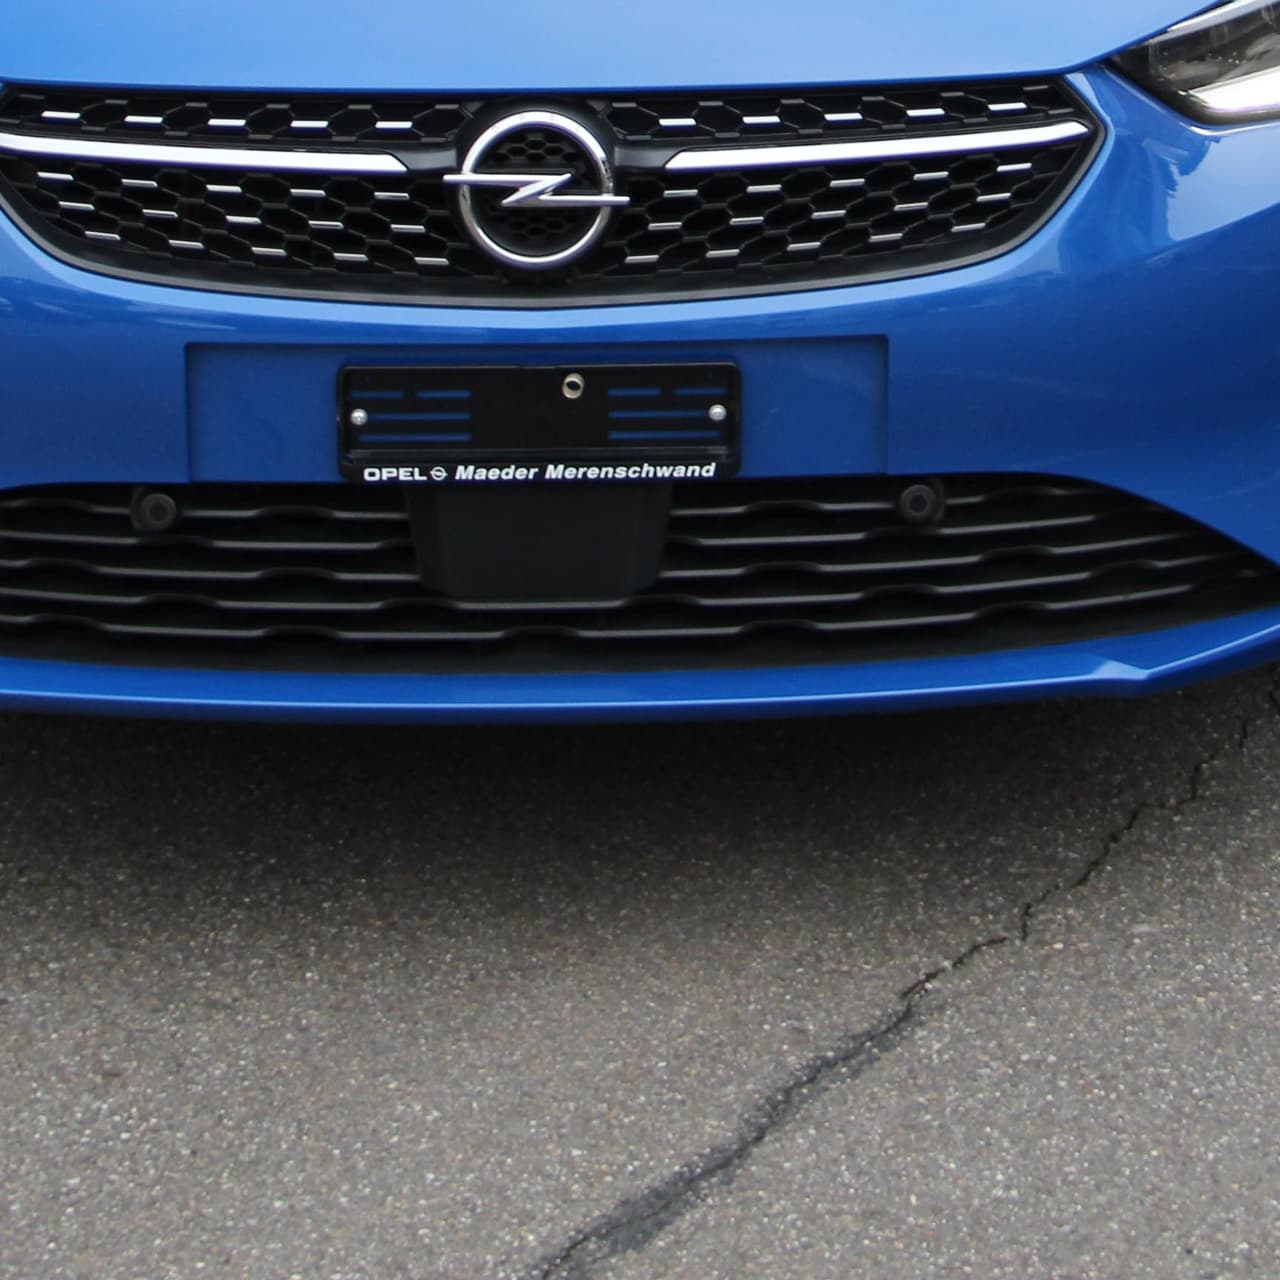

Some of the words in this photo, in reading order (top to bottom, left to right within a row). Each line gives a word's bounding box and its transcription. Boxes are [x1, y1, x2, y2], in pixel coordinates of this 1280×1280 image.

[362, 466, 428, 482] OPEL
[454, 464, 539, 481] Maeder
[544, 461, 717, 480] Merenschwand
